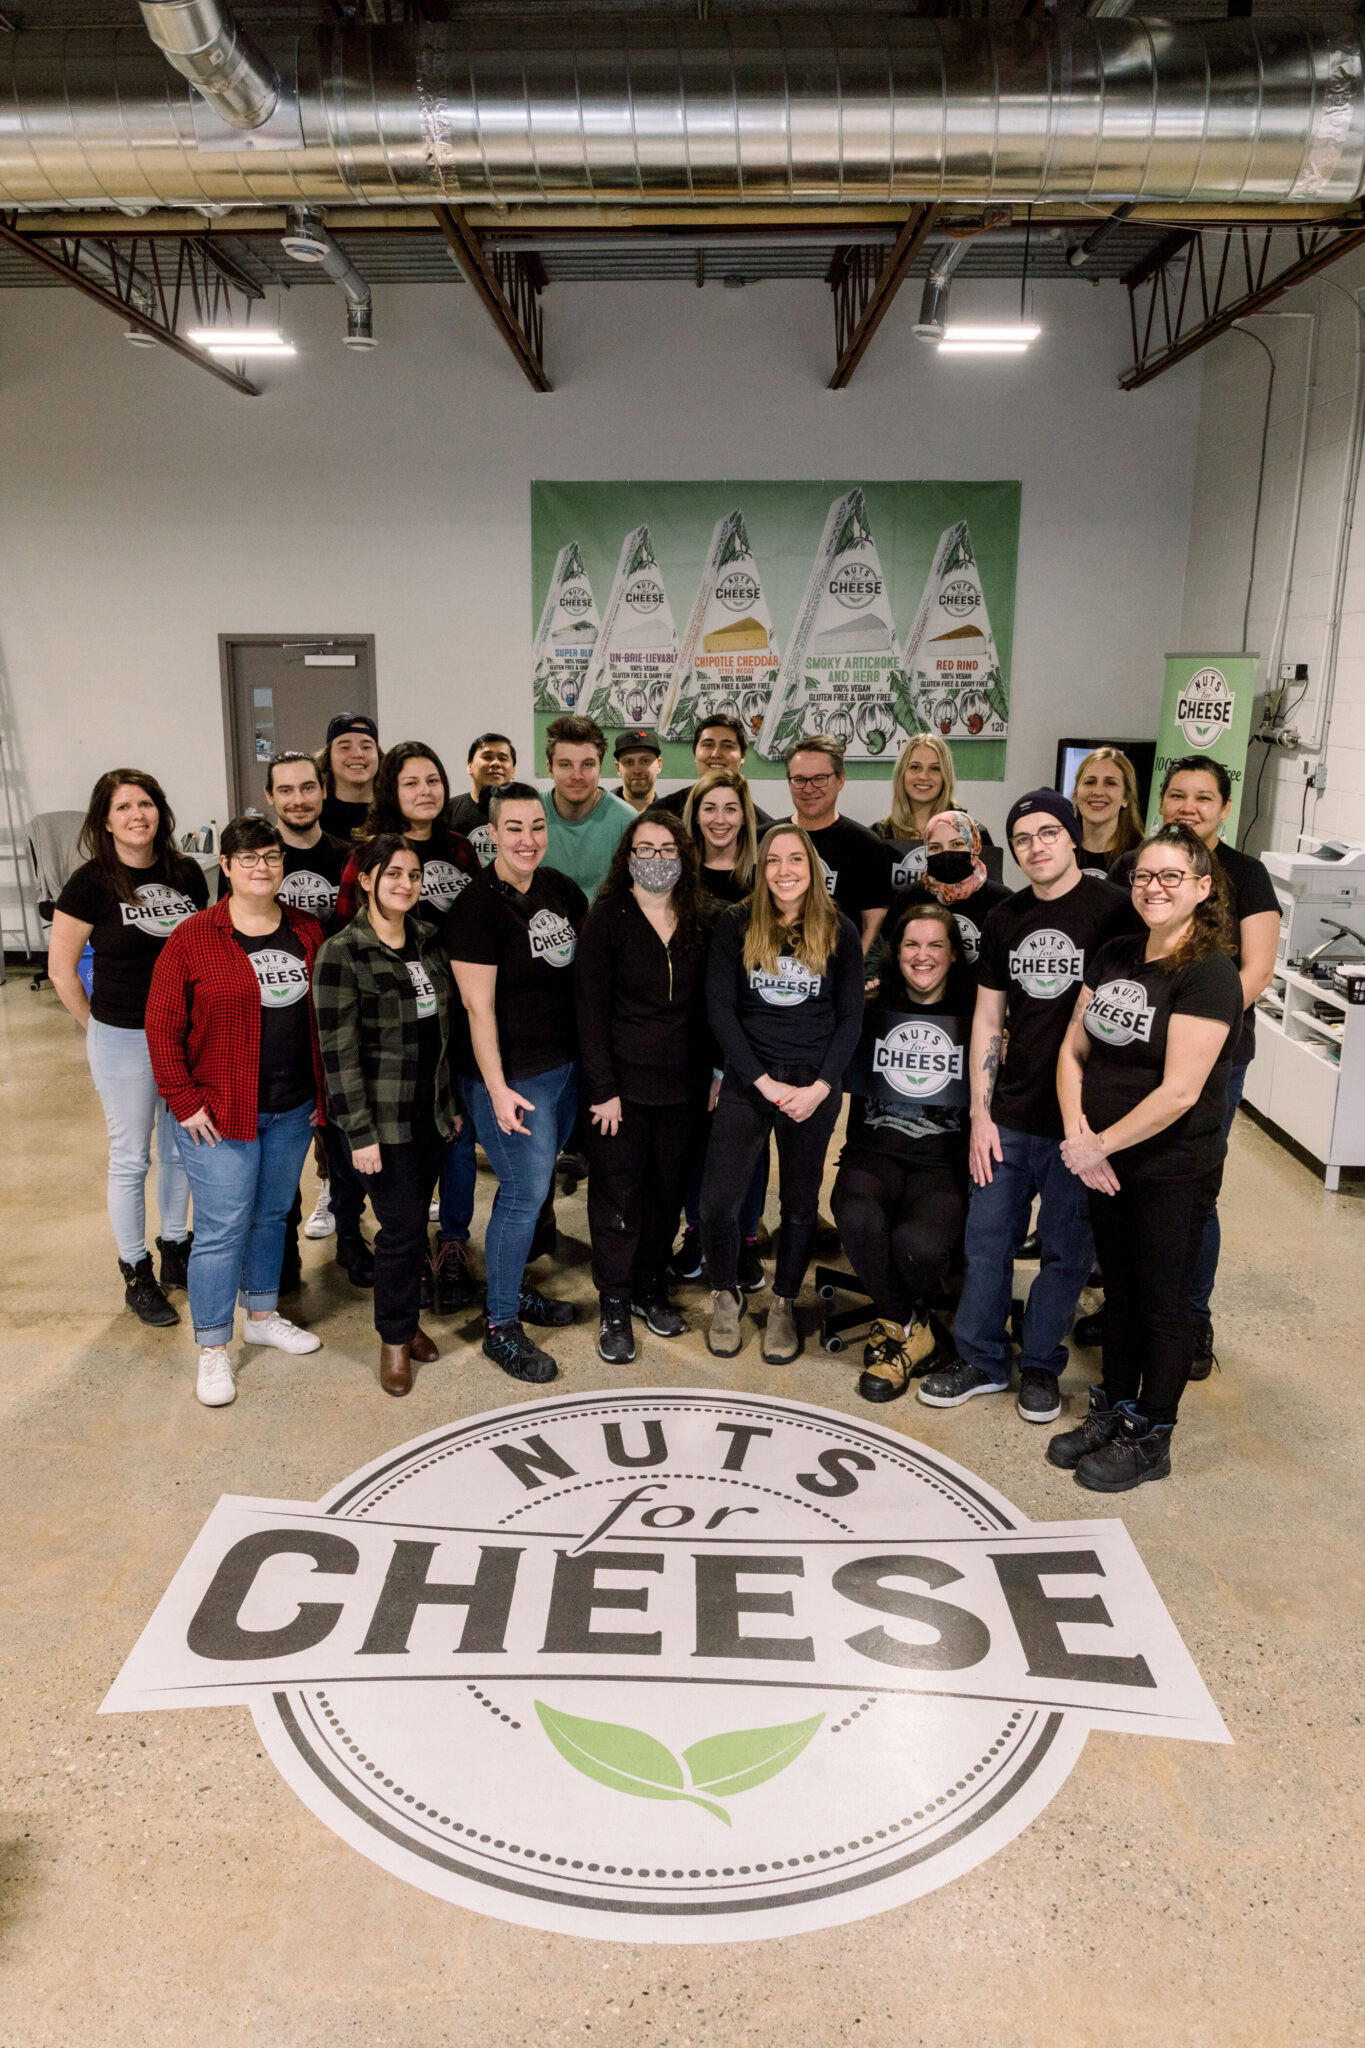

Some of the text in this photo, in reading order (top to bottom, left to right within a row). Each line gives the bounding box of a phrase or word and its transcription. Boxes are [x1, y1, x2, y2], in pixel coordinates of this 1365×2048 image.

[844, 567, 870, 576] NUTS
[728, 576, 750, 584] NUTS
[636, 582, 656, 590] NUTS
[830, 581, 882, 594] CHEESE
[951, 584, 972, 592] NUTS
[626, 593, 664, 603] CHEESE
[716, 588, 760, 599] CHEESE
[560, 598, 592, 607] CHEESE
[939, 595, 980, 606] CHEESE
[555, 648, 593, 658] SUPER BLU
[694, 656, 779, 667] CHIPOTLE CHEDDAR
[805, 656, 900, 669] SMOKY ARTICHOKE
[936, 660, 978, 670] RED RIND
[828, 671, 880, 682] AND HERB
[1195, 675, 1221, 692] NUTS
[1200, 689, 1211, 699] for
[1178, 699, 1231, 723] CHEESE
[991, 722, 1004, 732] 120
[474, 842, 498, 853] HEE
[426, 866, 453, 877] NUTS
[291, 877, 320, 888] NUTS
[139, 889, 172, 900] NUTS
[125, 900, 196, 920] CHEESE
[1030, 936, 1065, 950] NUTS
[254, 955, 288, 966] NUTS
[781, 962, 805, 974] UTS
[1011, 958, 1080, 976] CHEESE
[1112, 986, 1140, 1003] NUTS
[899, 1029, 941, 1045] NUTS
[910, 1042, 927, 1052] for
[877, 1047, 959, 1074] CHEESE
[489, 1420, 876, 1498] NUTS
[572, 1484, 759, 1554] for
[186, 1529, 1157, 1688] CHEESE
